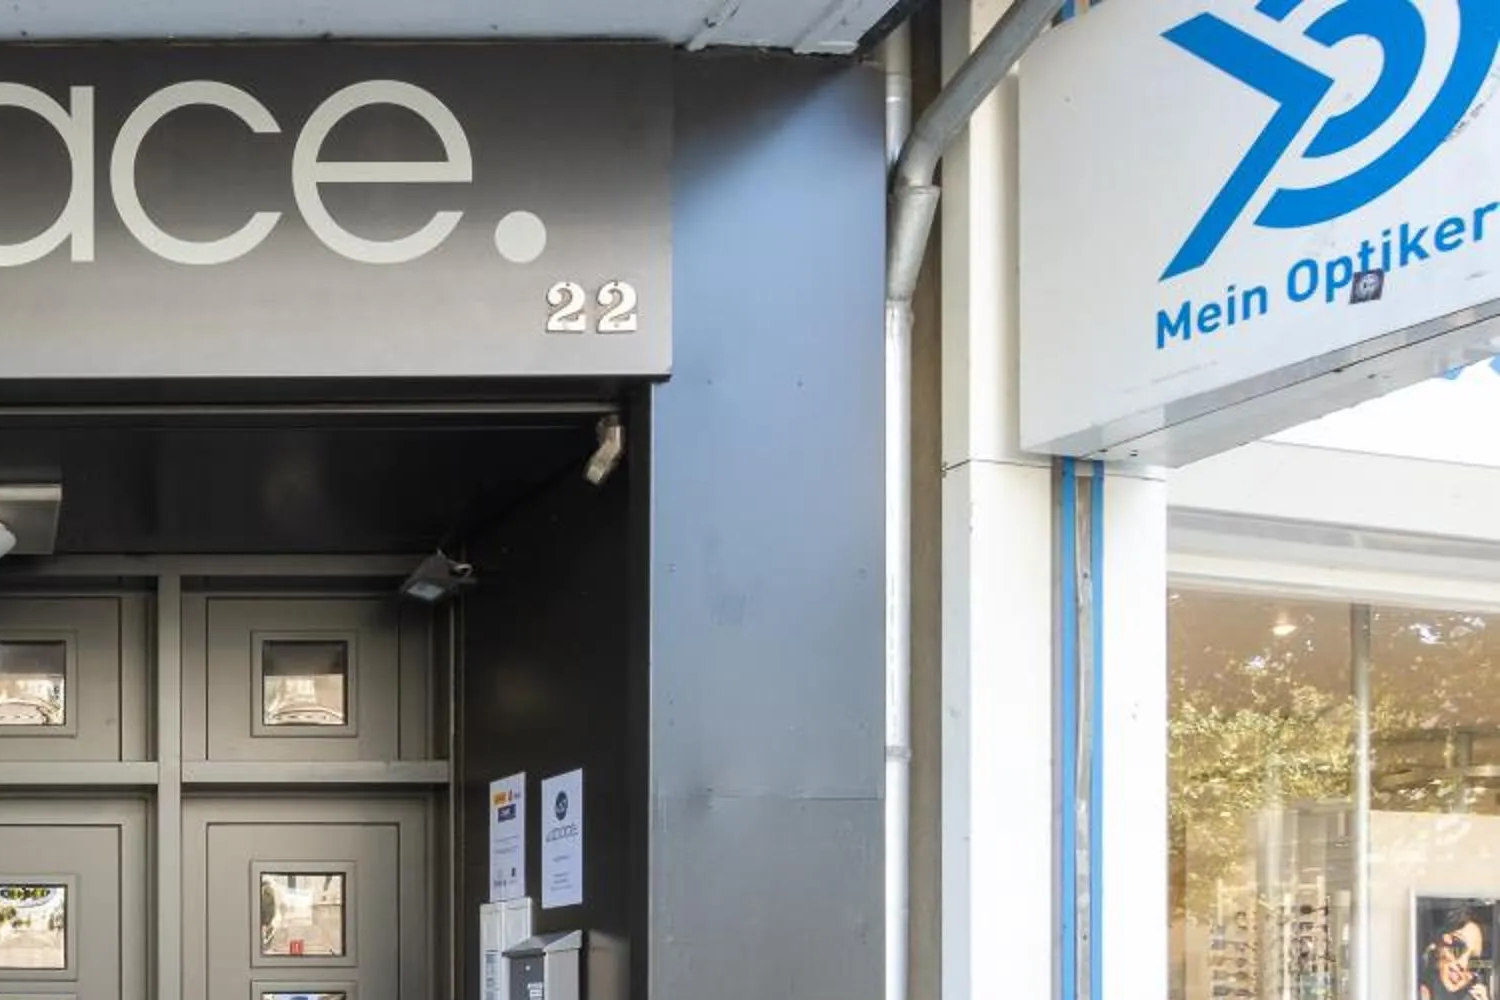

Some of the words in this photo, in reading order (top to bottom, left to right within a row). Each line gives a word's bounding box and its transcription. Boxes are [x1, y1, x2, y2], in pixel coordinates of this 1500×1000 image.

[546, 281, 638, 333] 22
[1156, 284, 1268, 349] Mein
[1286, 201, 1500, 303] Optiker
